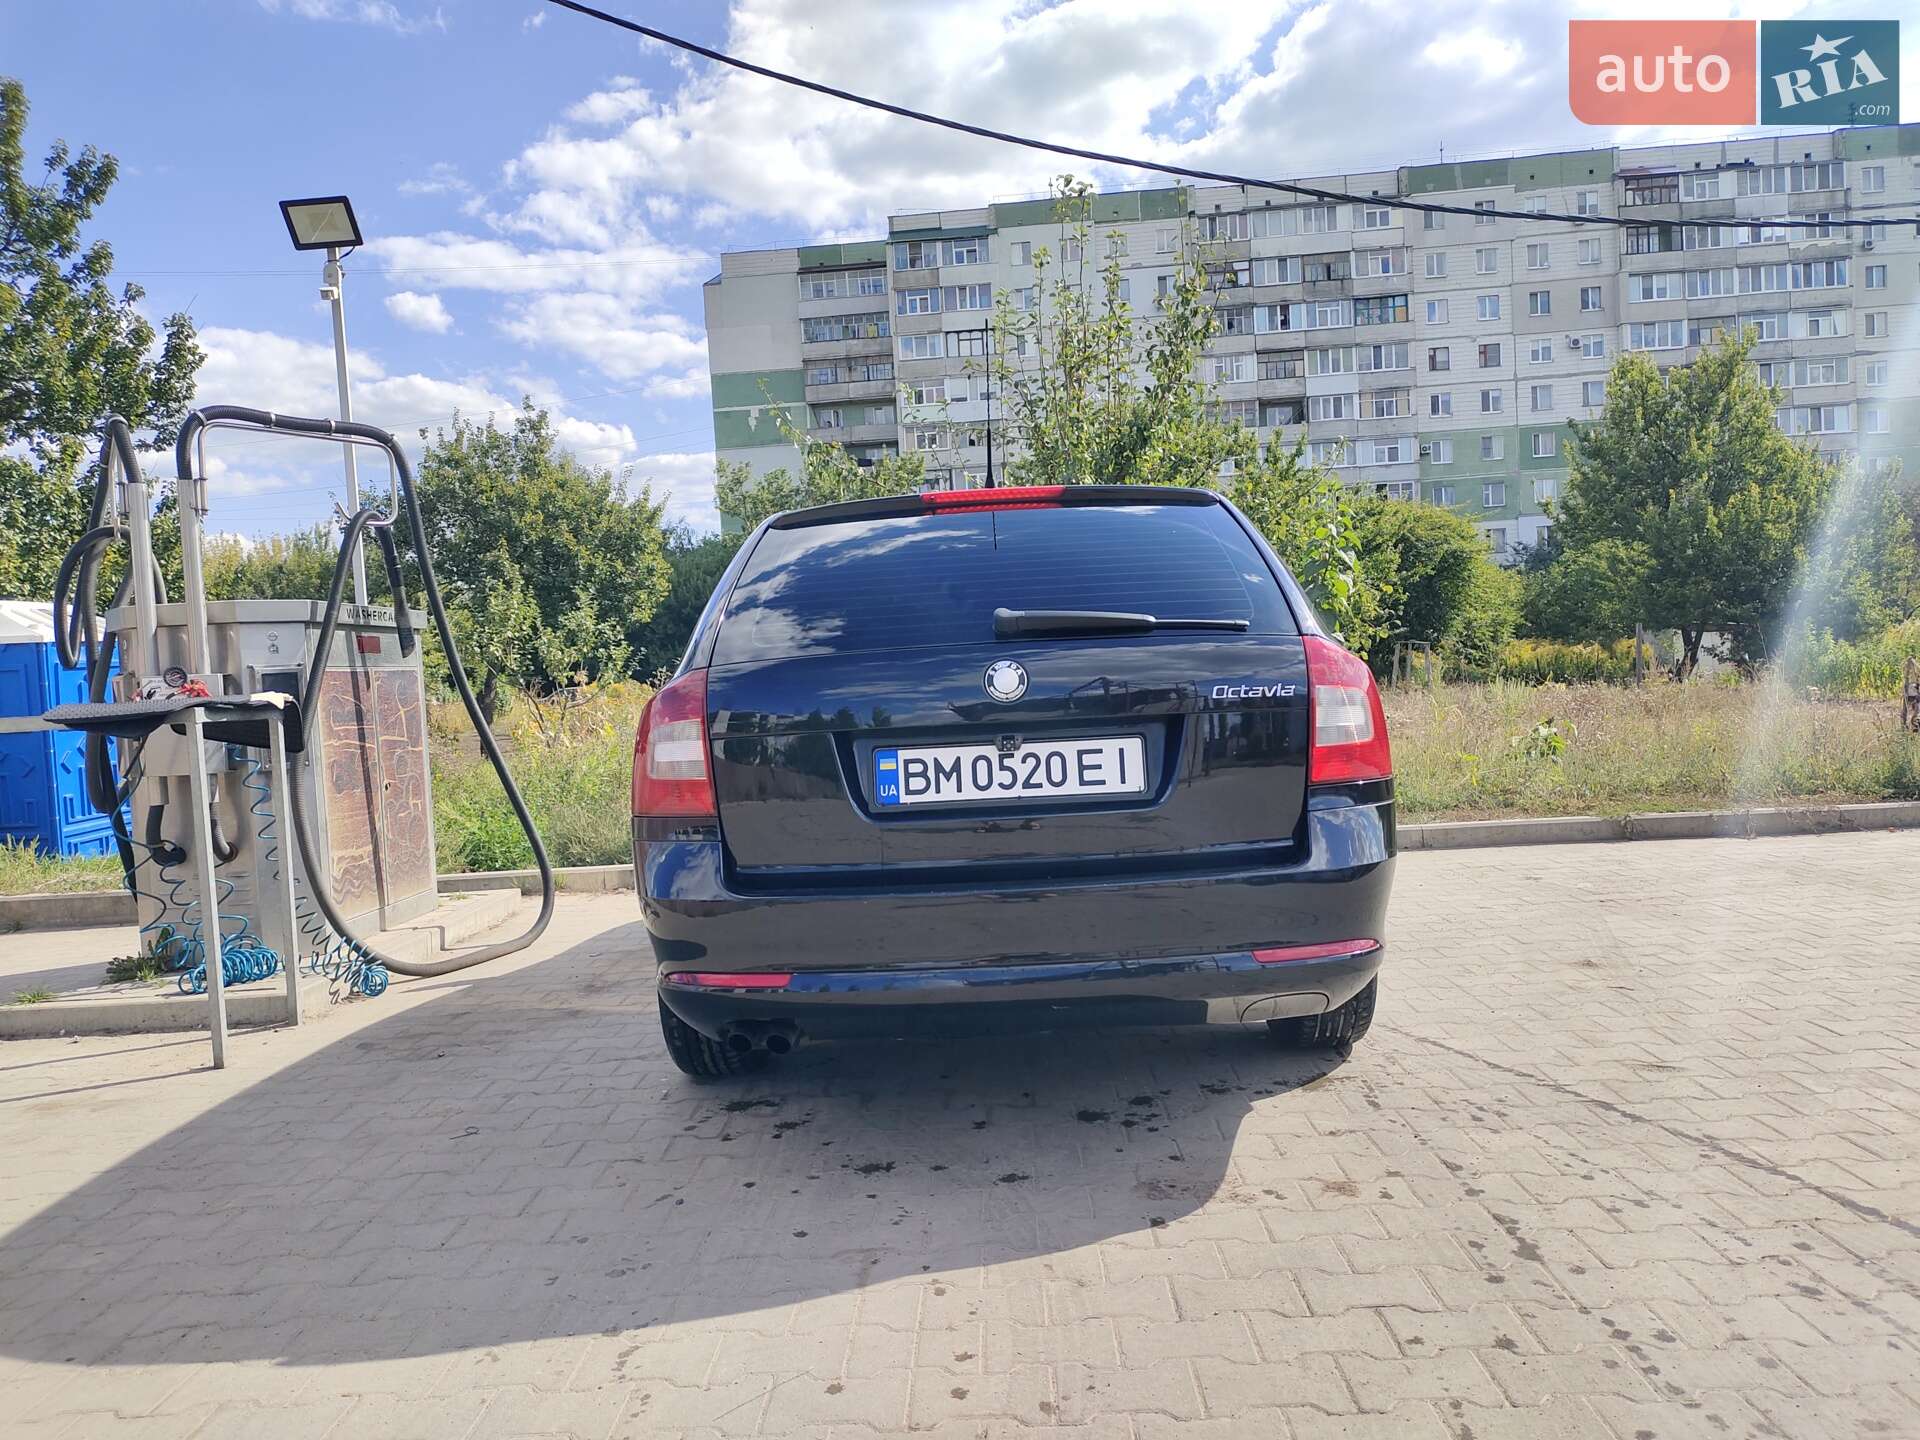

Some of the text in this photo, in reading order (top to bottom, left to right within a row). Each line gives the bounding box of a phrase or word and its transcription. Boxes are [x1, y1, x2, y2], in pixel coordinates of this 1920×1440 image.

[346, 607, 395, 622] WASHERCA
[1212, 683, 1295, 699] Octavia
[880, 784, 898, 797] UA
